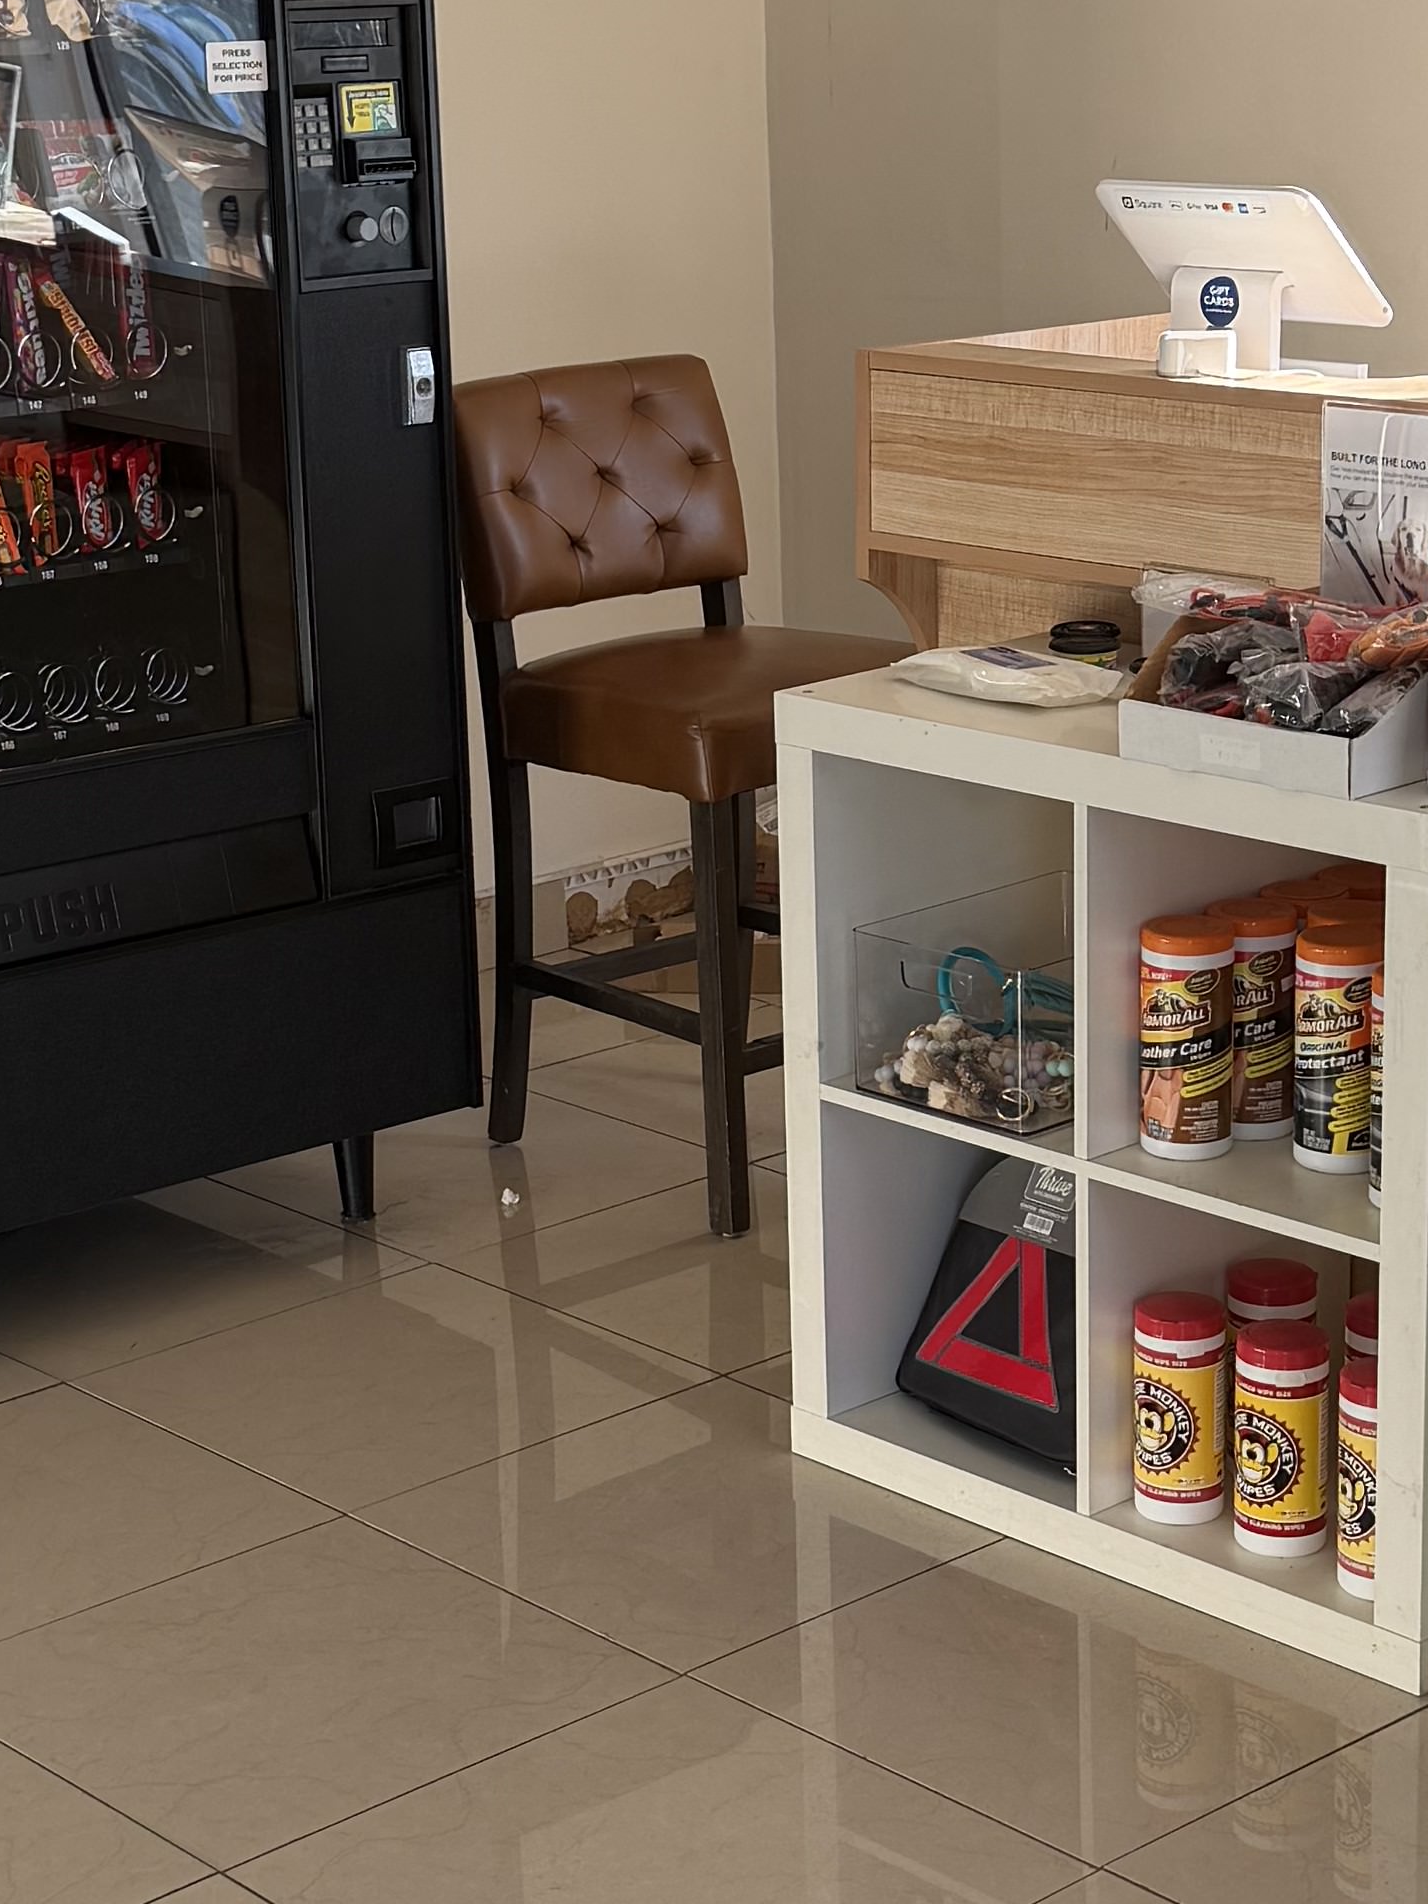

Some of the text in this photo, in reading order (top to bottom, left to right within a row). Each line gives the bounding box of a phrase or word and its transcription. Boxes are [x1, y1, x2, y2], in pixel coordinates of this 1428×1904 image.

[222, 49, 251, 57] PRESS
[212, 61, 262, 70] SELECTION
[1209, 285, 1231, 296] GIFT
[1204, 296, 1235, 307] CARDS
[1331, 451, 1357, 463] BUILT
[1359, 454, 1379, 465] FOR
[1381, 457, 1398, 468] THE
[1401, 459, 1426, 471] LONG
[1244, 1019, 1277, 1036] Care
[1180, 1038, 1213, 1056] Care
[1300, 1040, 1348, 1052] ORIGINAL
[1035, 1166, 1073, 1197] Thrive
[1150, 1385, 1190, 1444] MONKEY
[1252, 1416, 1293, 1476] MONKEY
